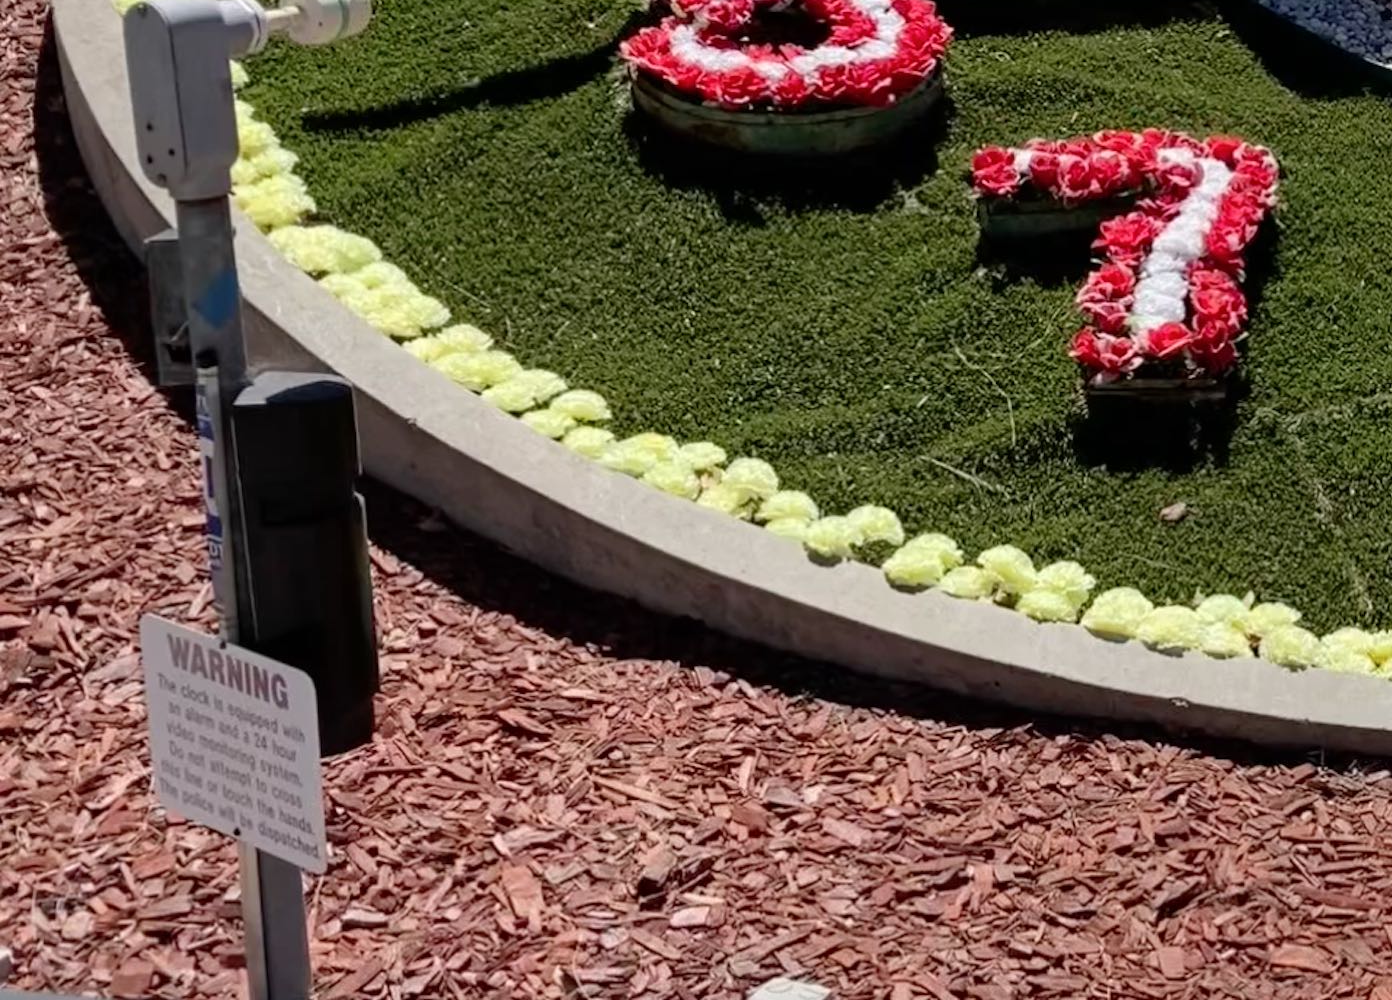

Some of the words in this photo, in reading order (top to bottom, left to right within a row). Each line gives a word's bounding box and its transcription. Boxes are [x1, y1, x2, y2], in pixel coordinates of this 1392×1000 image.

[970, 128, 1280, 382] 7
[166, 634, 290, 711] WARNING
[157, 672, 176, 694] The
[180, 683, 209, 706] clock
[227, 704, 279, 735] equipped
[283, 724, 306, 743] with
[168, 702, 182, 715] an
[185, 706, 215, 729] alarm
[218, 720, 239, 739] and
[243, 731, 250, 744] a
[254, 732, 268, 750] 24
[272, 741, 297, 762] hour
[166, 721, 195, 743] video
[199, 735, 256, 769] monitoring
[260, 758, 303, 788] system.
[168, 740, 184, 759] Do
[187, 752, 205, 768] not
[209, 760, 251, 787] attempt
[256, 777, 268, 793] to
[271, 786, 303, 809] cross
[159, 776, 179, 798] The
[182, 789, 215, 814] police
[239, 813, 254, 830] be
[207, 780, 218, 793] or
[222, 783, 254, 809] touch
[257, 797, 275, 818] the
